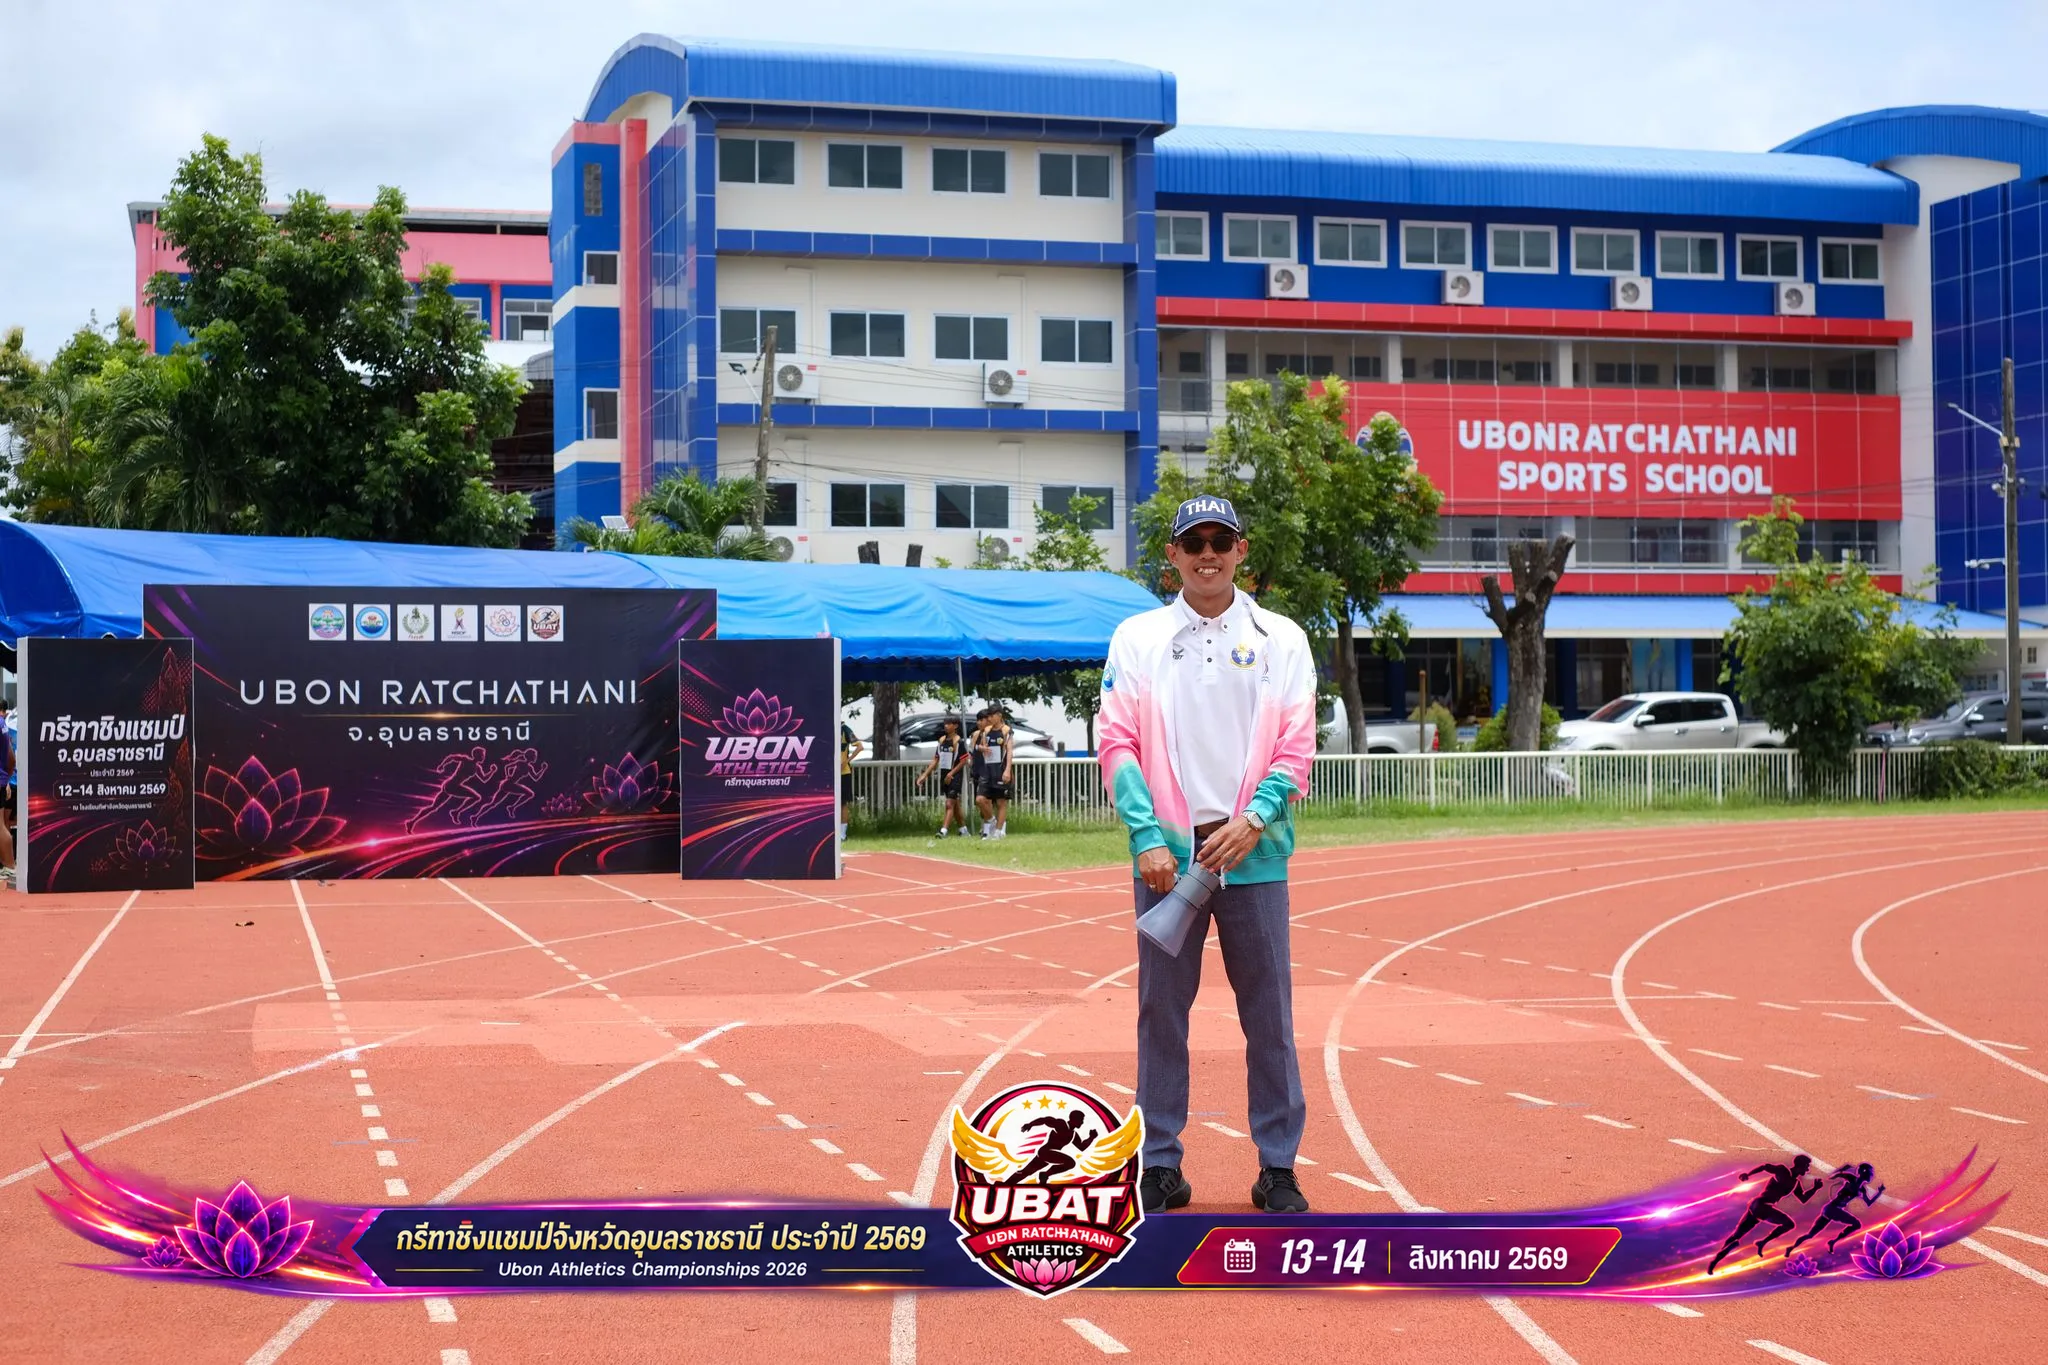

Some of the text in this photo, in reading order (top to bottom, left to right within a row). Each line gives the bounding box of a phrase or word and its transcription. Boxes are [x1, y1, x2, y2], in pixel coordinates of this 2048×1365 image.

[1458, 420, 1797, 456] UBONRATCHATHANI
[1499, 460, 1772, 495] SPORTS SCHOOL
[1185, 500, 1226, 516] THAI
[240, 679, 636, 705] UBON RATCHATHANI
[349, 720, 530, 748] จ.อุบลราชธานี
[57, 742, 165, 767] จ.อุบลราชธานี
[705, 736, 816, 761] UBON
[116, 768, 135, 777] 2569
[705, 761, 810, 776] ATHLETICS
[96, 783, 137, 796] สิงหาคม
[139, 783, 166, 795] 2569
